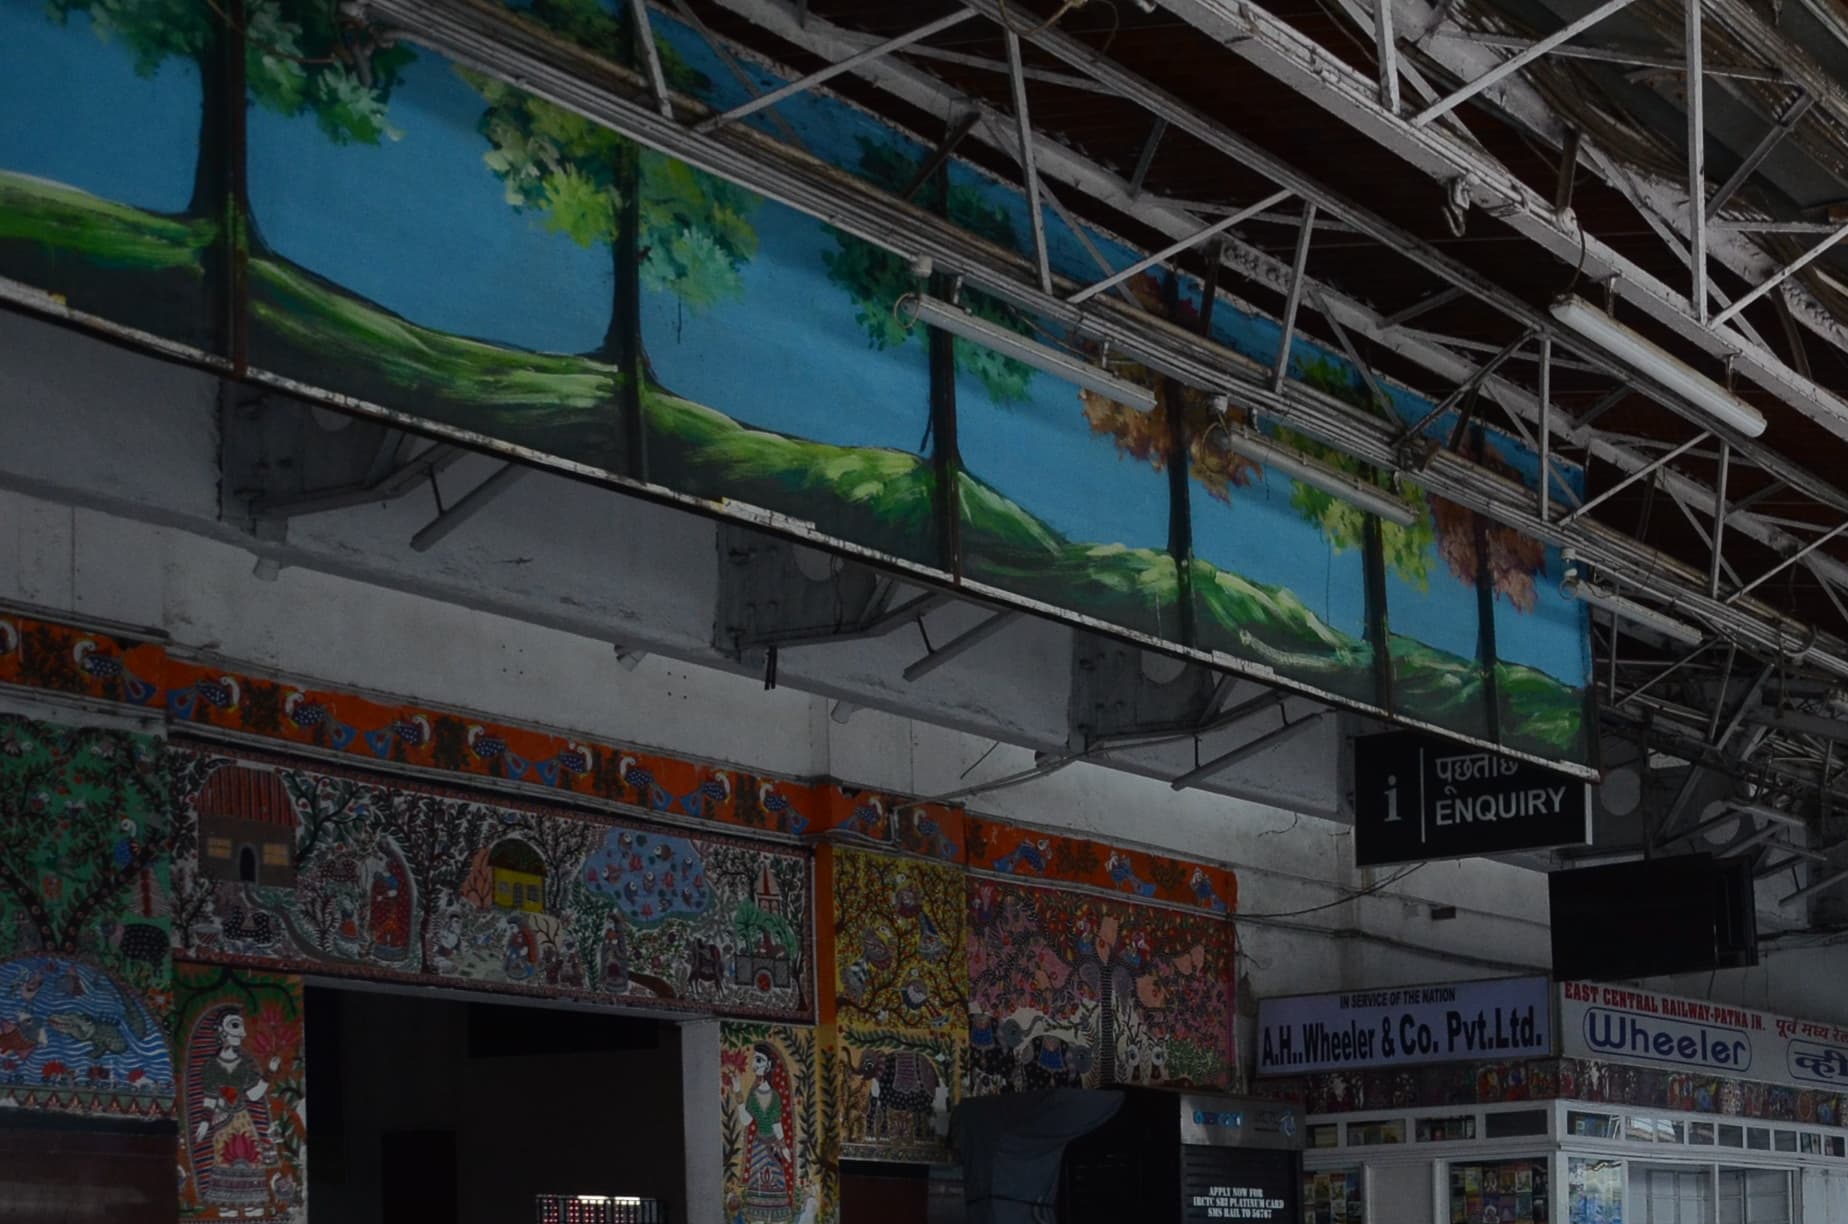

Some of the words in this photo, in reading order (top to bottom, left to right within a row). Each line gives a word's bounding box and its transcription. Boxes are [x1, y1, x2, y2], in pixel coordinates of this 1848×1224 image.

[1435, 785, 1567, 826] ENQUIRY
[1340, 995, 1350, 1008] IN
[1351, 991, 1387, 1008] SERVICE
[1390, 991, 1401, 1006] OF
[1403, 989, 1420, 1005] THE
[1422, 987, 1455, 1004] NATION
[1564, 982, 1599, 1002] EAST
[1602, 988, 1658, 1012] CENTRAL
[1381, 1016, 1395, 1057] &
[1399, 1014, 1439, 1055] Co.
[1589, 1012, 1746, 1065] Wheeler
[1209, 1186, 1231, 1197] APPLY
[1232, 1187, 1247, 1197] NOW
[1249, 1188, 1264, 1198] FOR
[1216, 1197, 1228, 1207] SBI
[1230, 1198, 1265, 1208] PLATINUM
[1265, 1199, 1285, 1209] CARD
[1208, 1207, 1223, 1217] SMS
[1224, 1208, 1240, 1218] RAIL
[1241, 1209, 1251, 1218] TO
